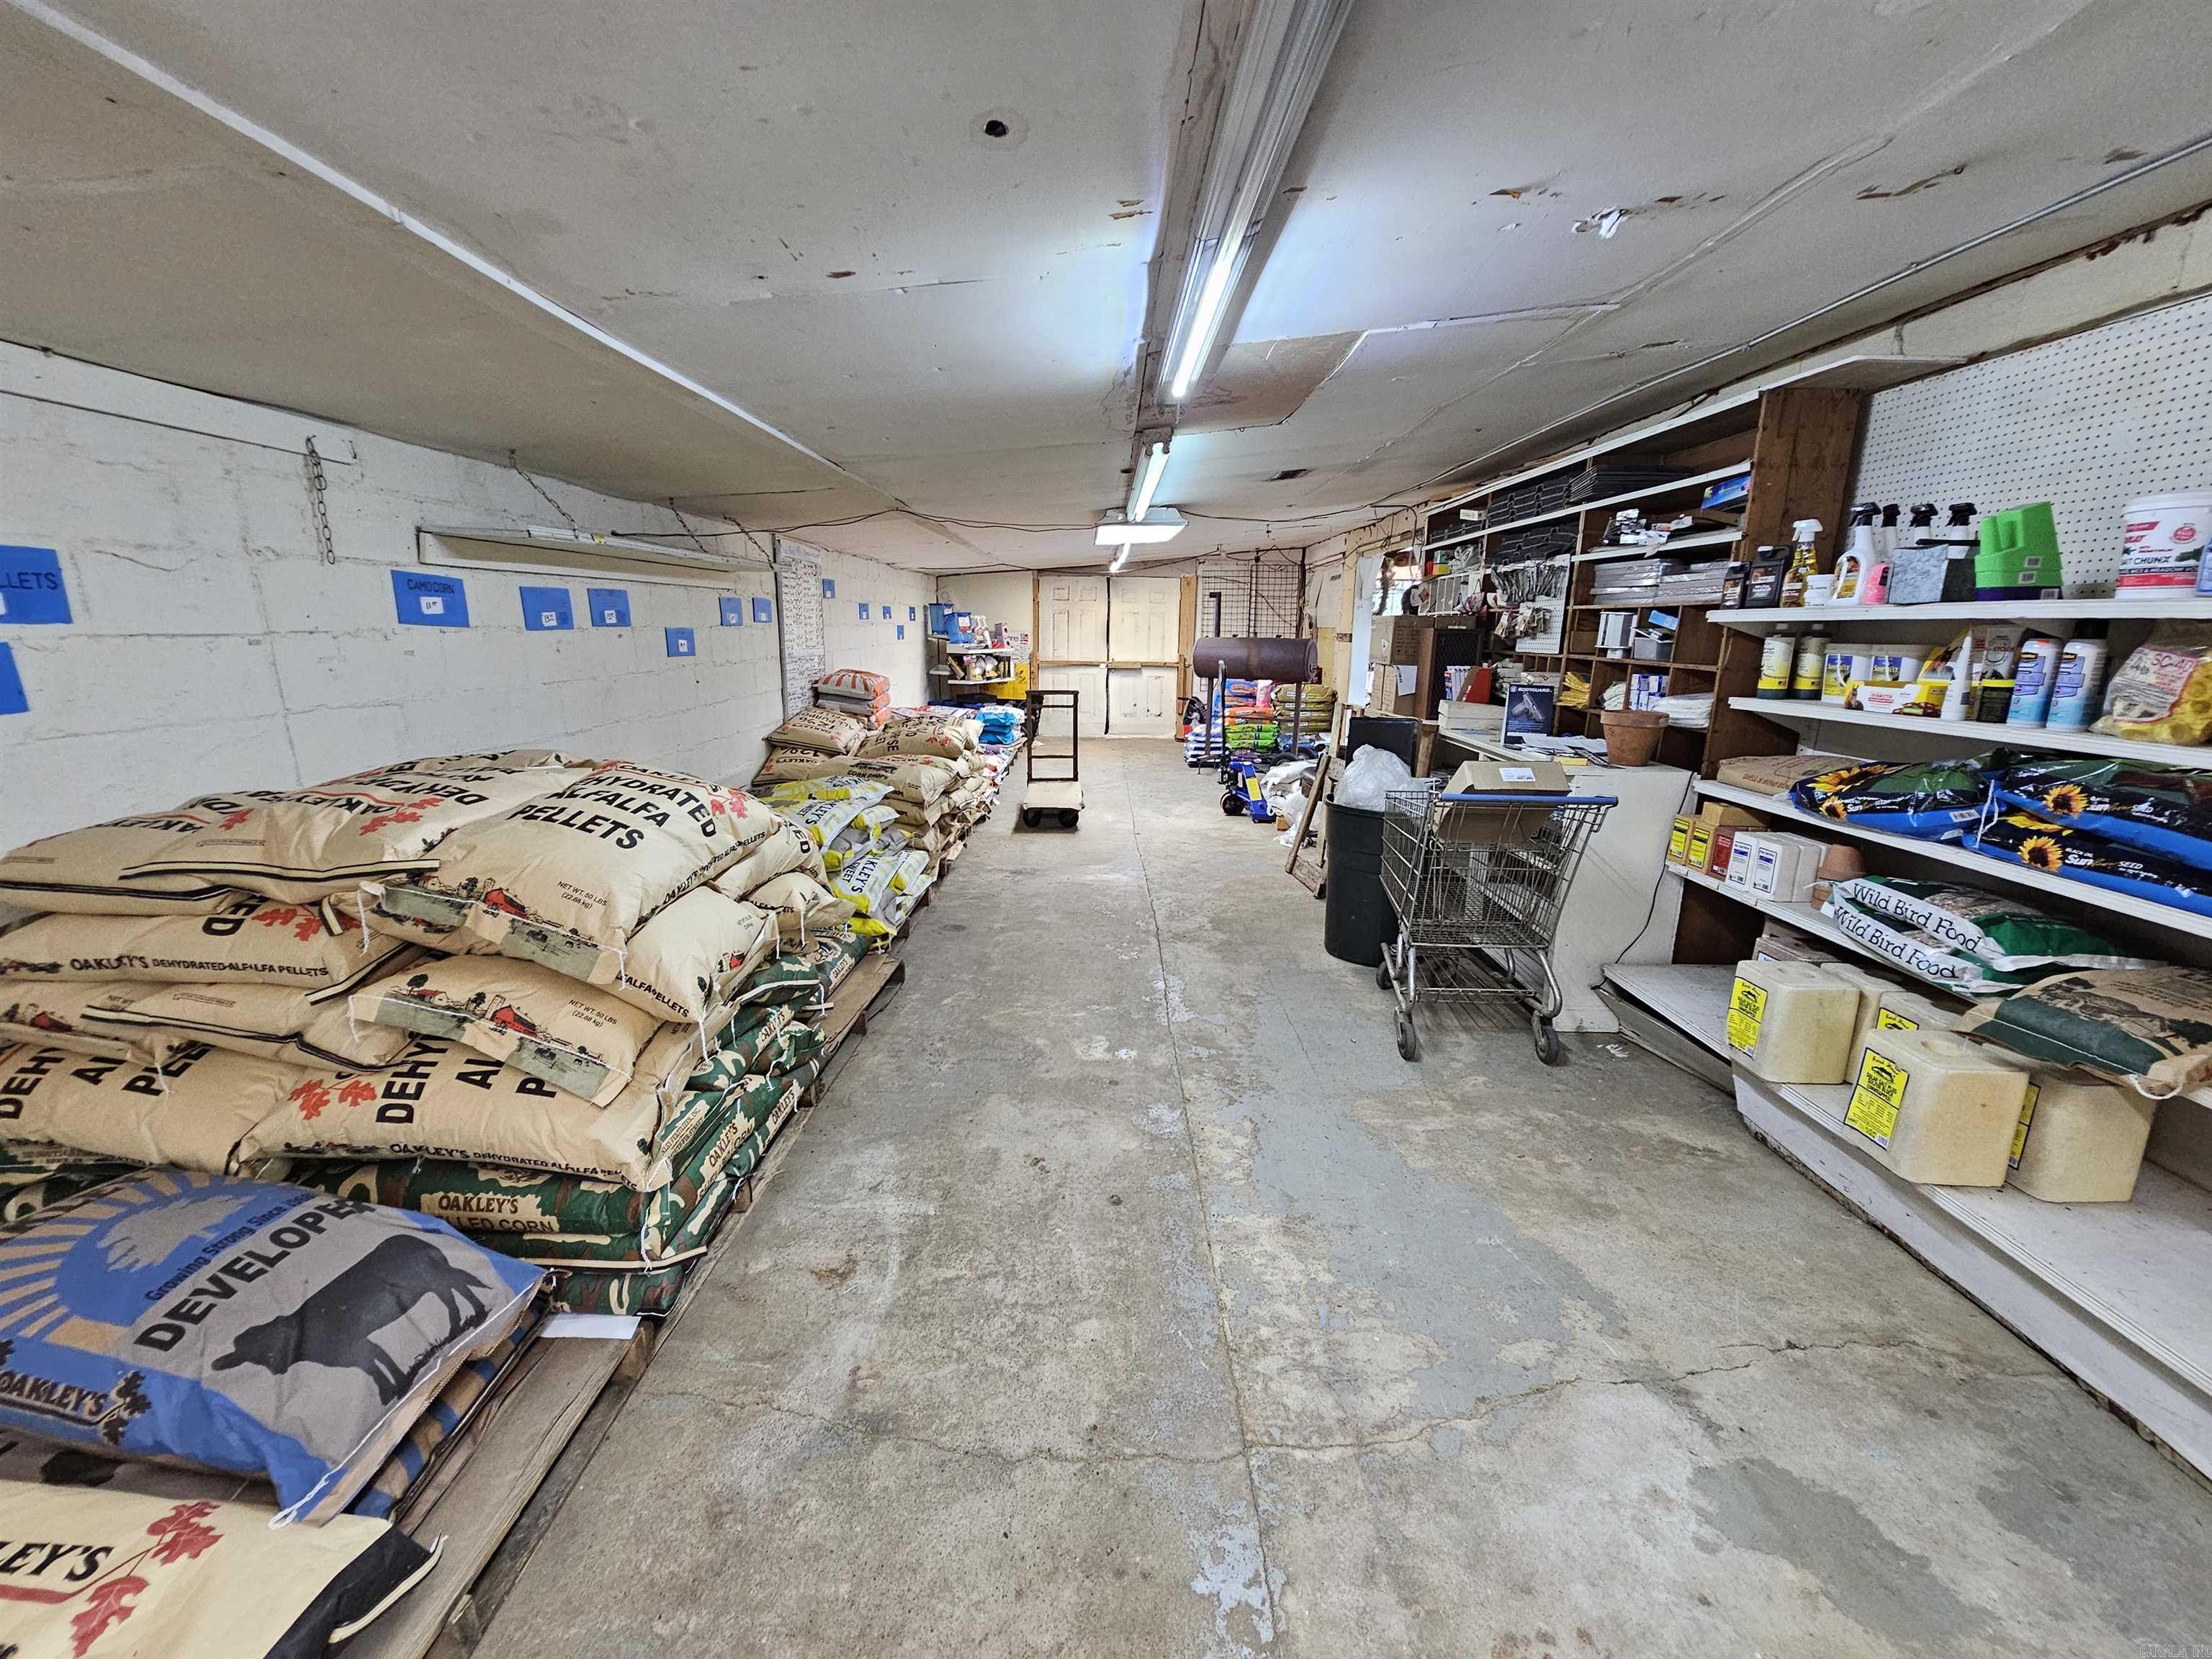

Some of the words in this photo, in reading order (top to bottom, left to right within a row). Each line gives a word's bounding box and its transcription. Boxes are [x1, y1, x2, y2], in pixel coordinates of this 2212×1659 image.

[544, 786, 670, 829] ALFALFA
[505, 804, 644, 850] PELLETS
[2119, 860, 2144, 870] SEED
[557, 881, 572, 891] NET
[593, 896, 608, 907] LBS
[1853, 883, 1891, 912] Wild
[1893, 899, 1933, 929] Bird
[1933, 917, 1982, 955] Food
[1835, 906, 1871, 939] Wild
[1868, 928, 1907, 960] Bird
[1906, 948, 1959, 979] Food
[152, 958, 227, 971] DEHYDRATED
[278, 963, 329, 976] PELLETS
[569, 999, 584, 1009] NET
[604, 1015, 617, 1025] LBS
[390, 1143, 469, 1159] OAKLEY'S
[473, 1151, 548, 1168] DEHYDRATED
[438, 1195, 518, 1215] OAKLEY'S
[498, 1219, 554, 1233] CORN
[145, 1255, 210, 1302] Growing
[202, 1226, 253, 1257] Strong
[247, 1205, 287, 1227] Since
[0, 1370, 110, 1417] OAKLEY'S
